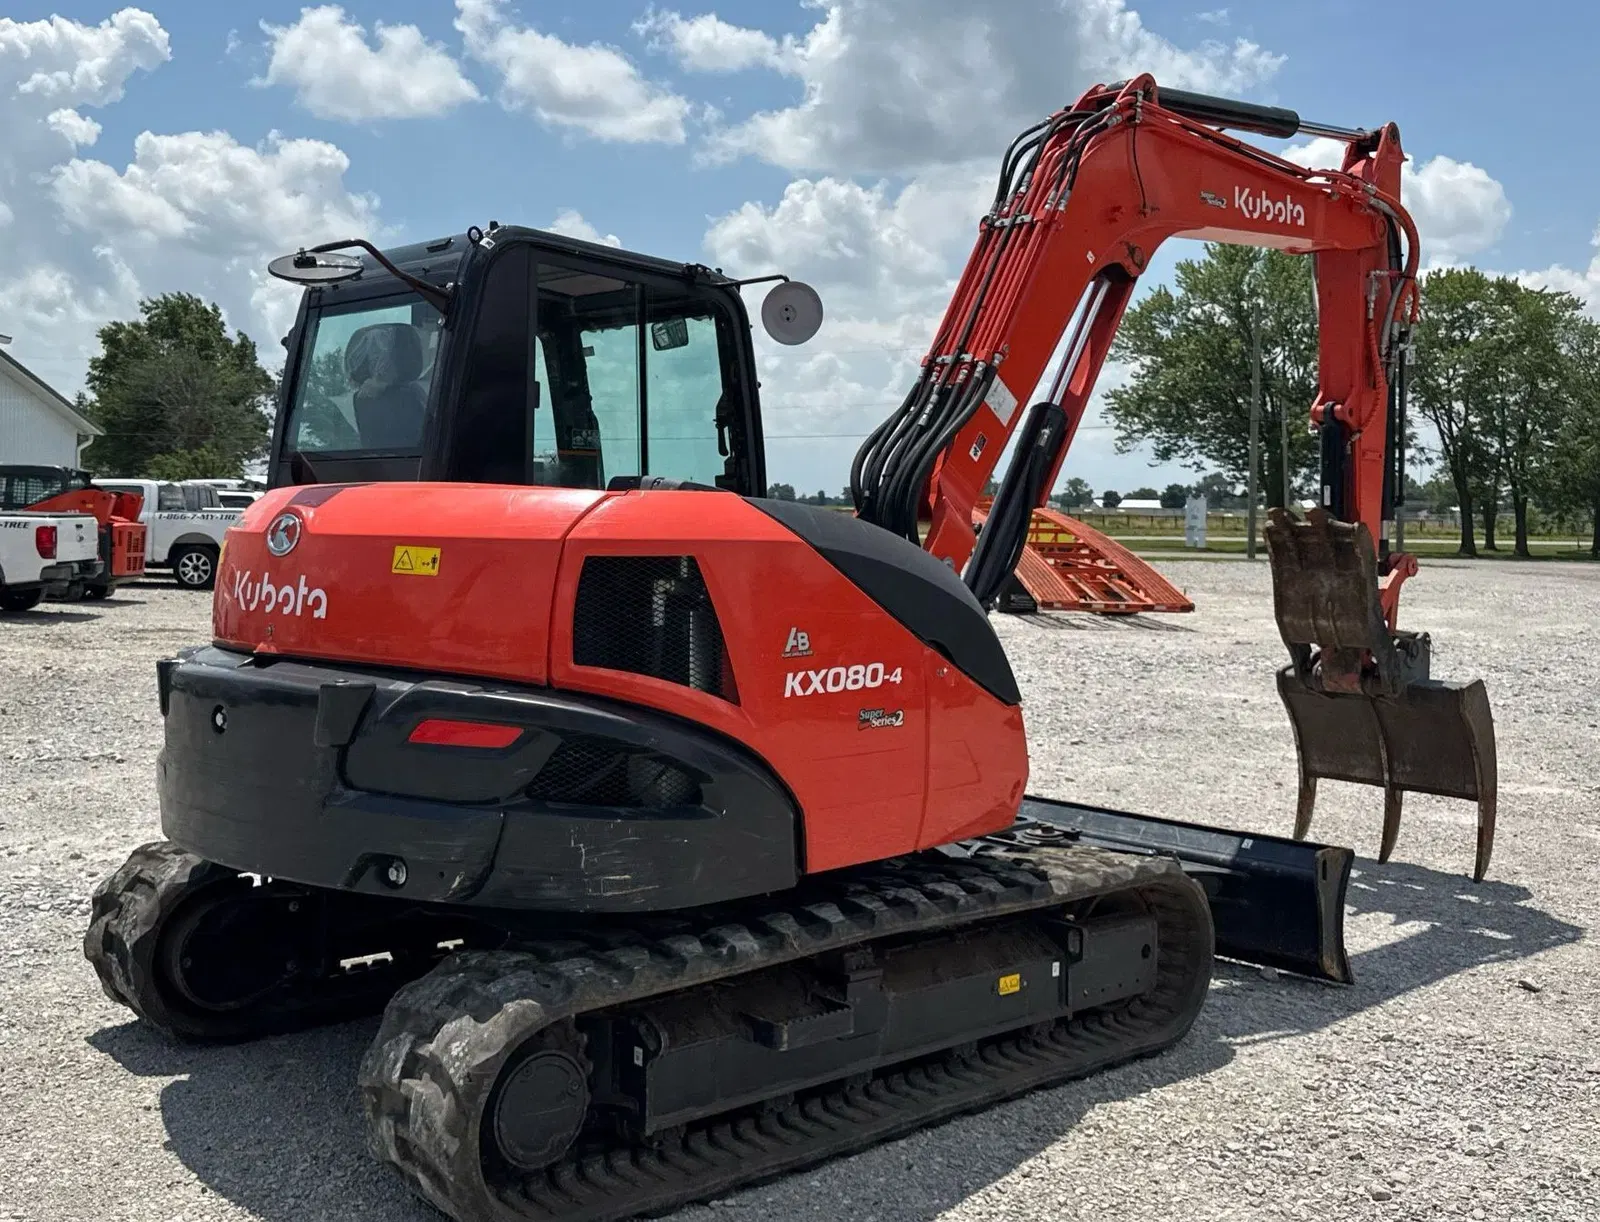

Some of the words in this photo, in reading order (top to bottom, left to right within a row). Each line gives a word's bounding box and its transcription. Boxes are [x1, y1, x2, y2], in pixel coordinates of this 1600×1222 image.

[1235, 186, 1305, 226] Kubota
[234, 571, 327, 619] Kubota
[784, 662, 902, 698] KX080-4
[860, 709, 884, 720] Super
